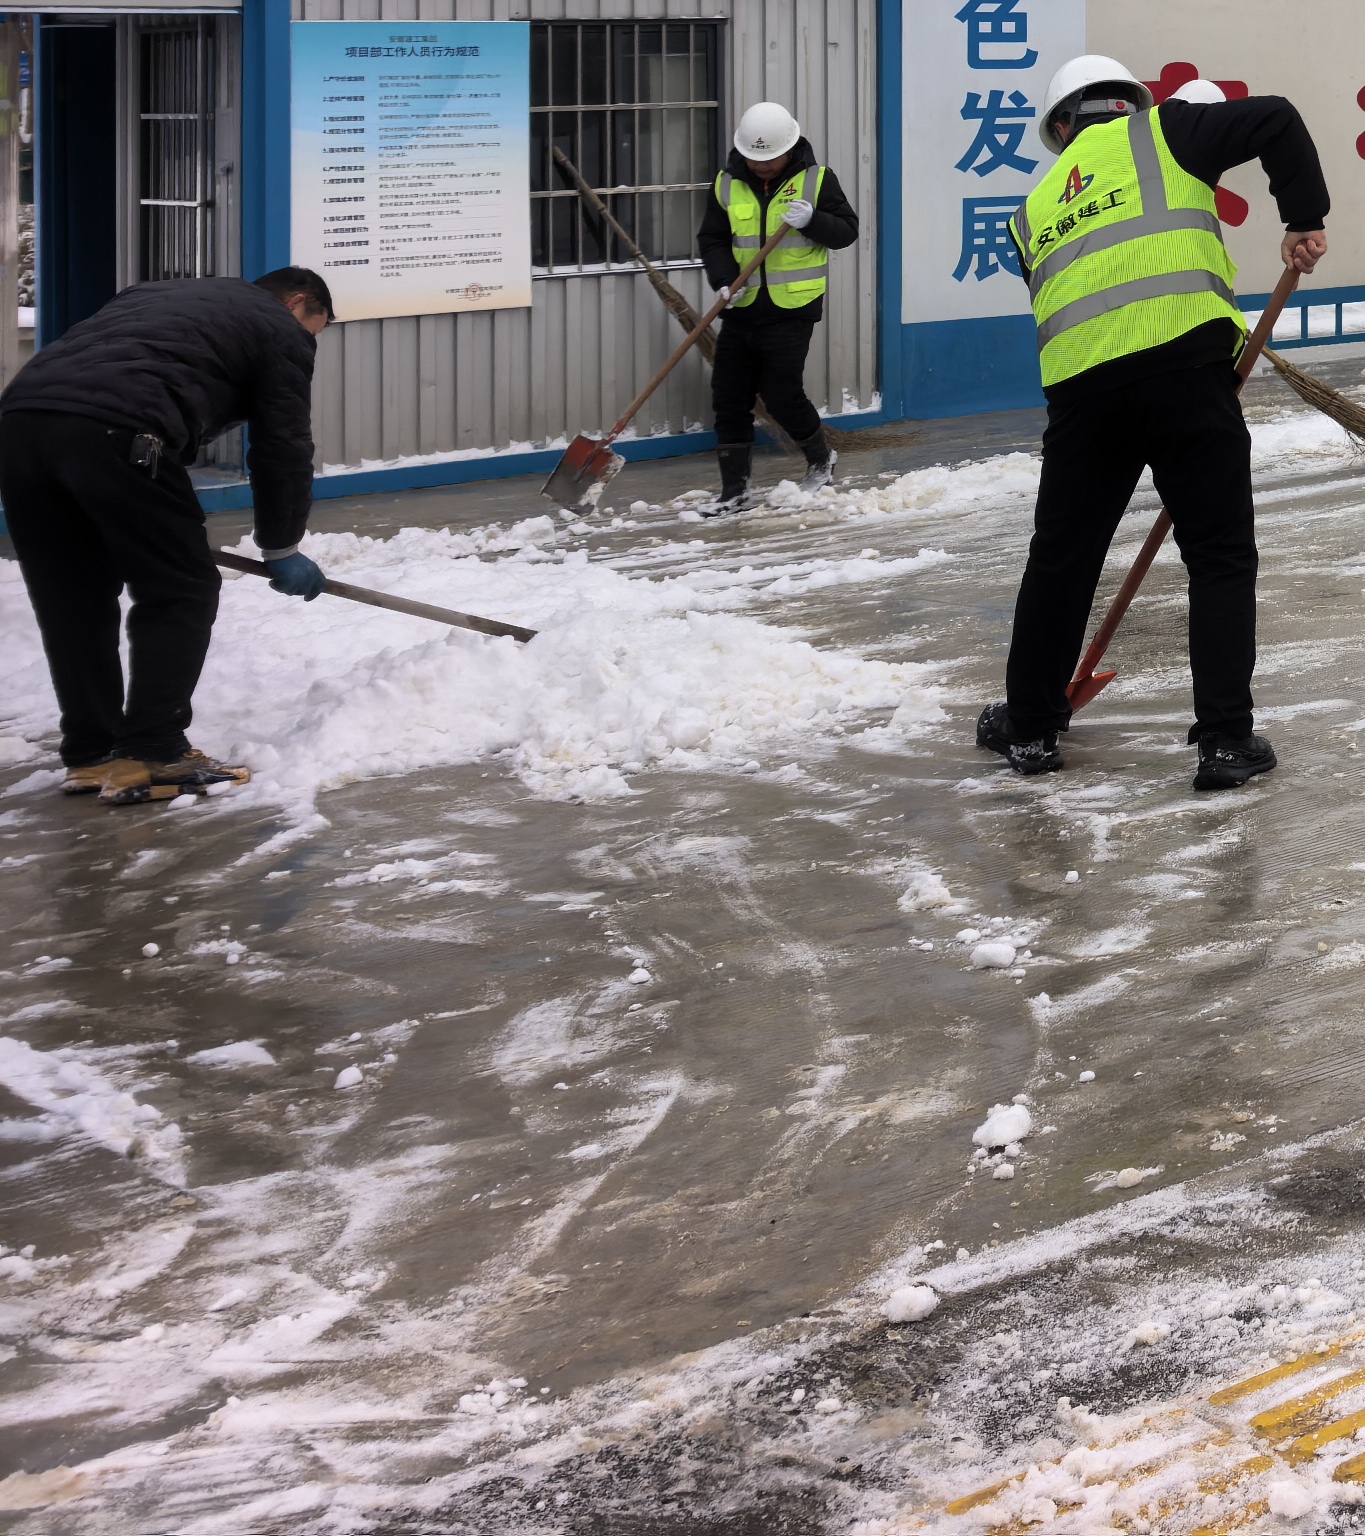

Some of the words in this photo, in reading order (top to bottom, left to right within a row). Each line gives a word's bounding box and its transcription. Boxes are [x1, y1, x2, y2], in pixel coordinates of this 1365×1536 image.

[345, 46, 480, 58] 项目部工作人员行为规范
[1037, 188, 1126, 252] 安徽建工
